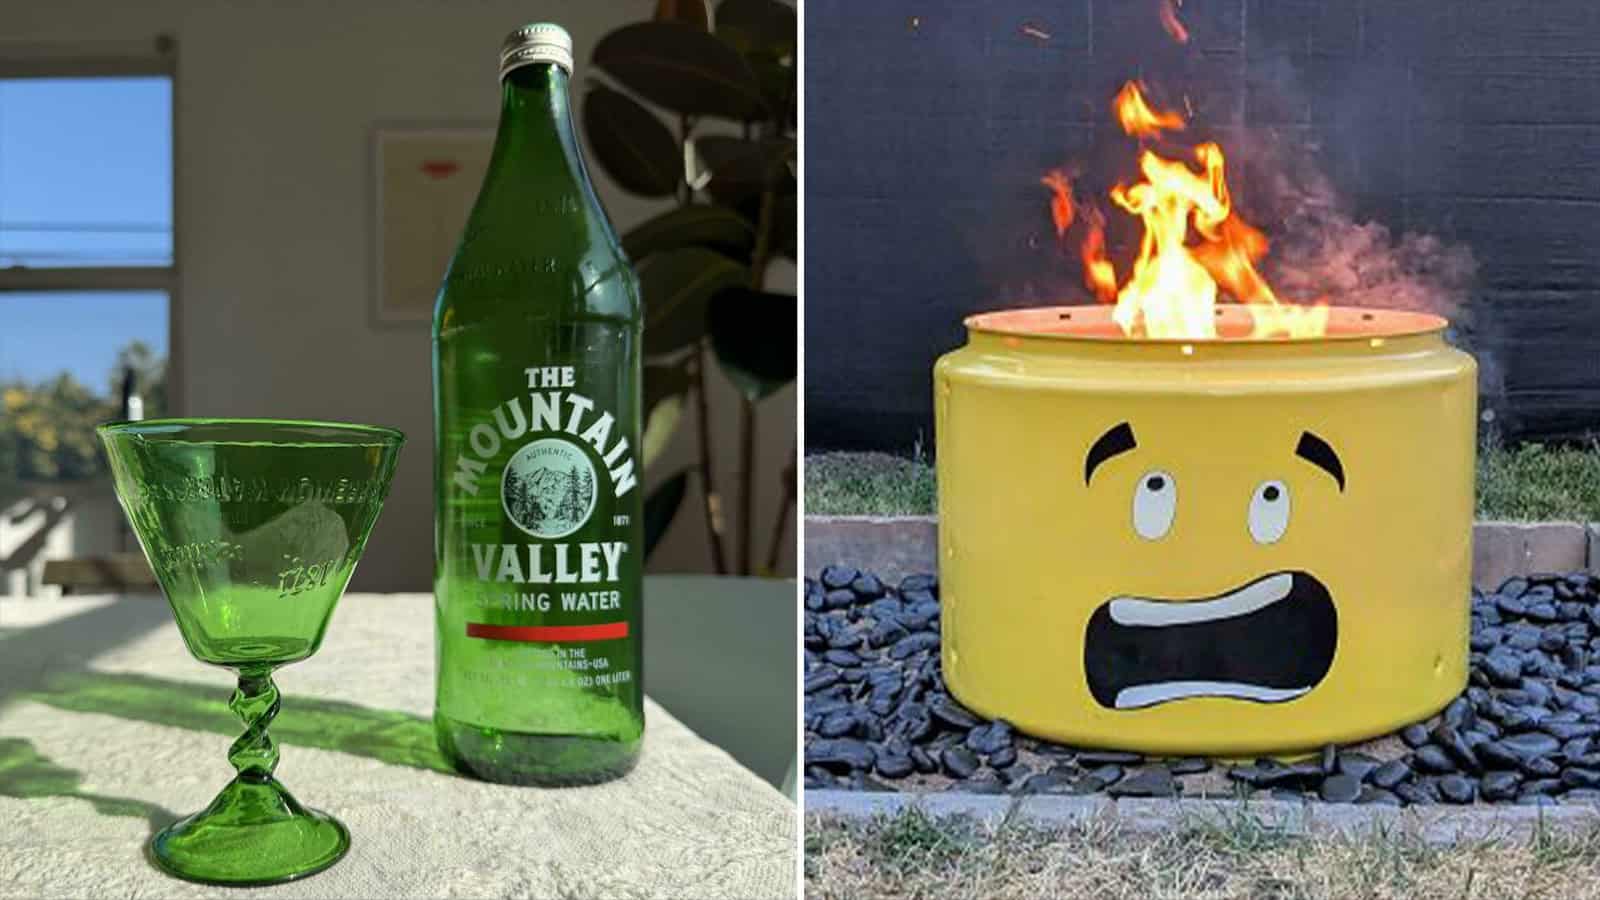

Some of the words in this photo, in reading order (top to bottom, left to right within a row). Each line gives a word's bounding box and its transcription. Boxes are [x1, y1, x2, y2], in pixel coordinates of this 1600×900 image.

[524, 366, 576, 389] THE
[453, 391, 638, 498] MOUNTAIN
[526, 447, 574, 461] AUTHENTIC
[471, 542, 624, 584] VALLEY
[561, 591, 621, 611] WATER
[568, 647, 585, 658] THE
